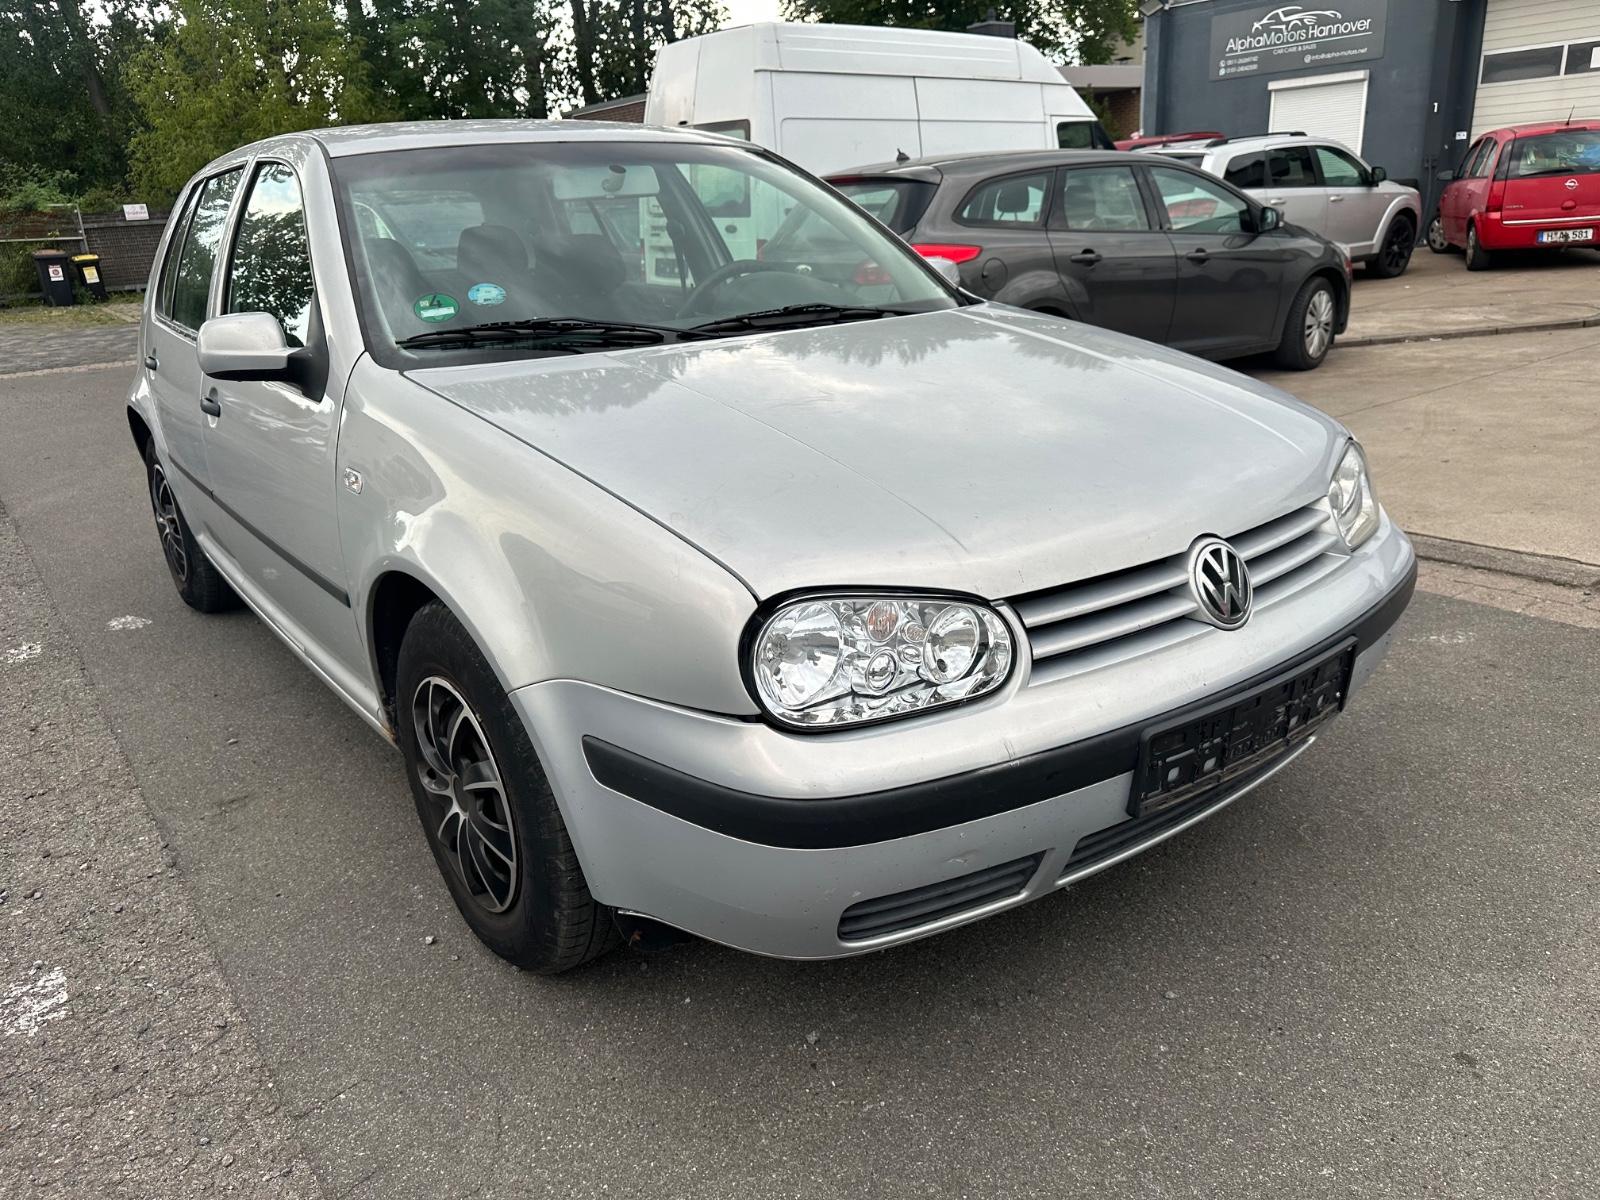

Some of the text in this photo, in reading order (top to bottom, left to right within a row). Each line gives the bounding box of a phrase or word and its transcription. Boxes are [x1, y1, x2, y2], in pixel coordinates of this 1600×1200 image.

[1226, 18, 1372, 52] AlphaMotors Hannover
[1572, 230, 1589, 239] 581
[430, 295, 442, 308] 4
